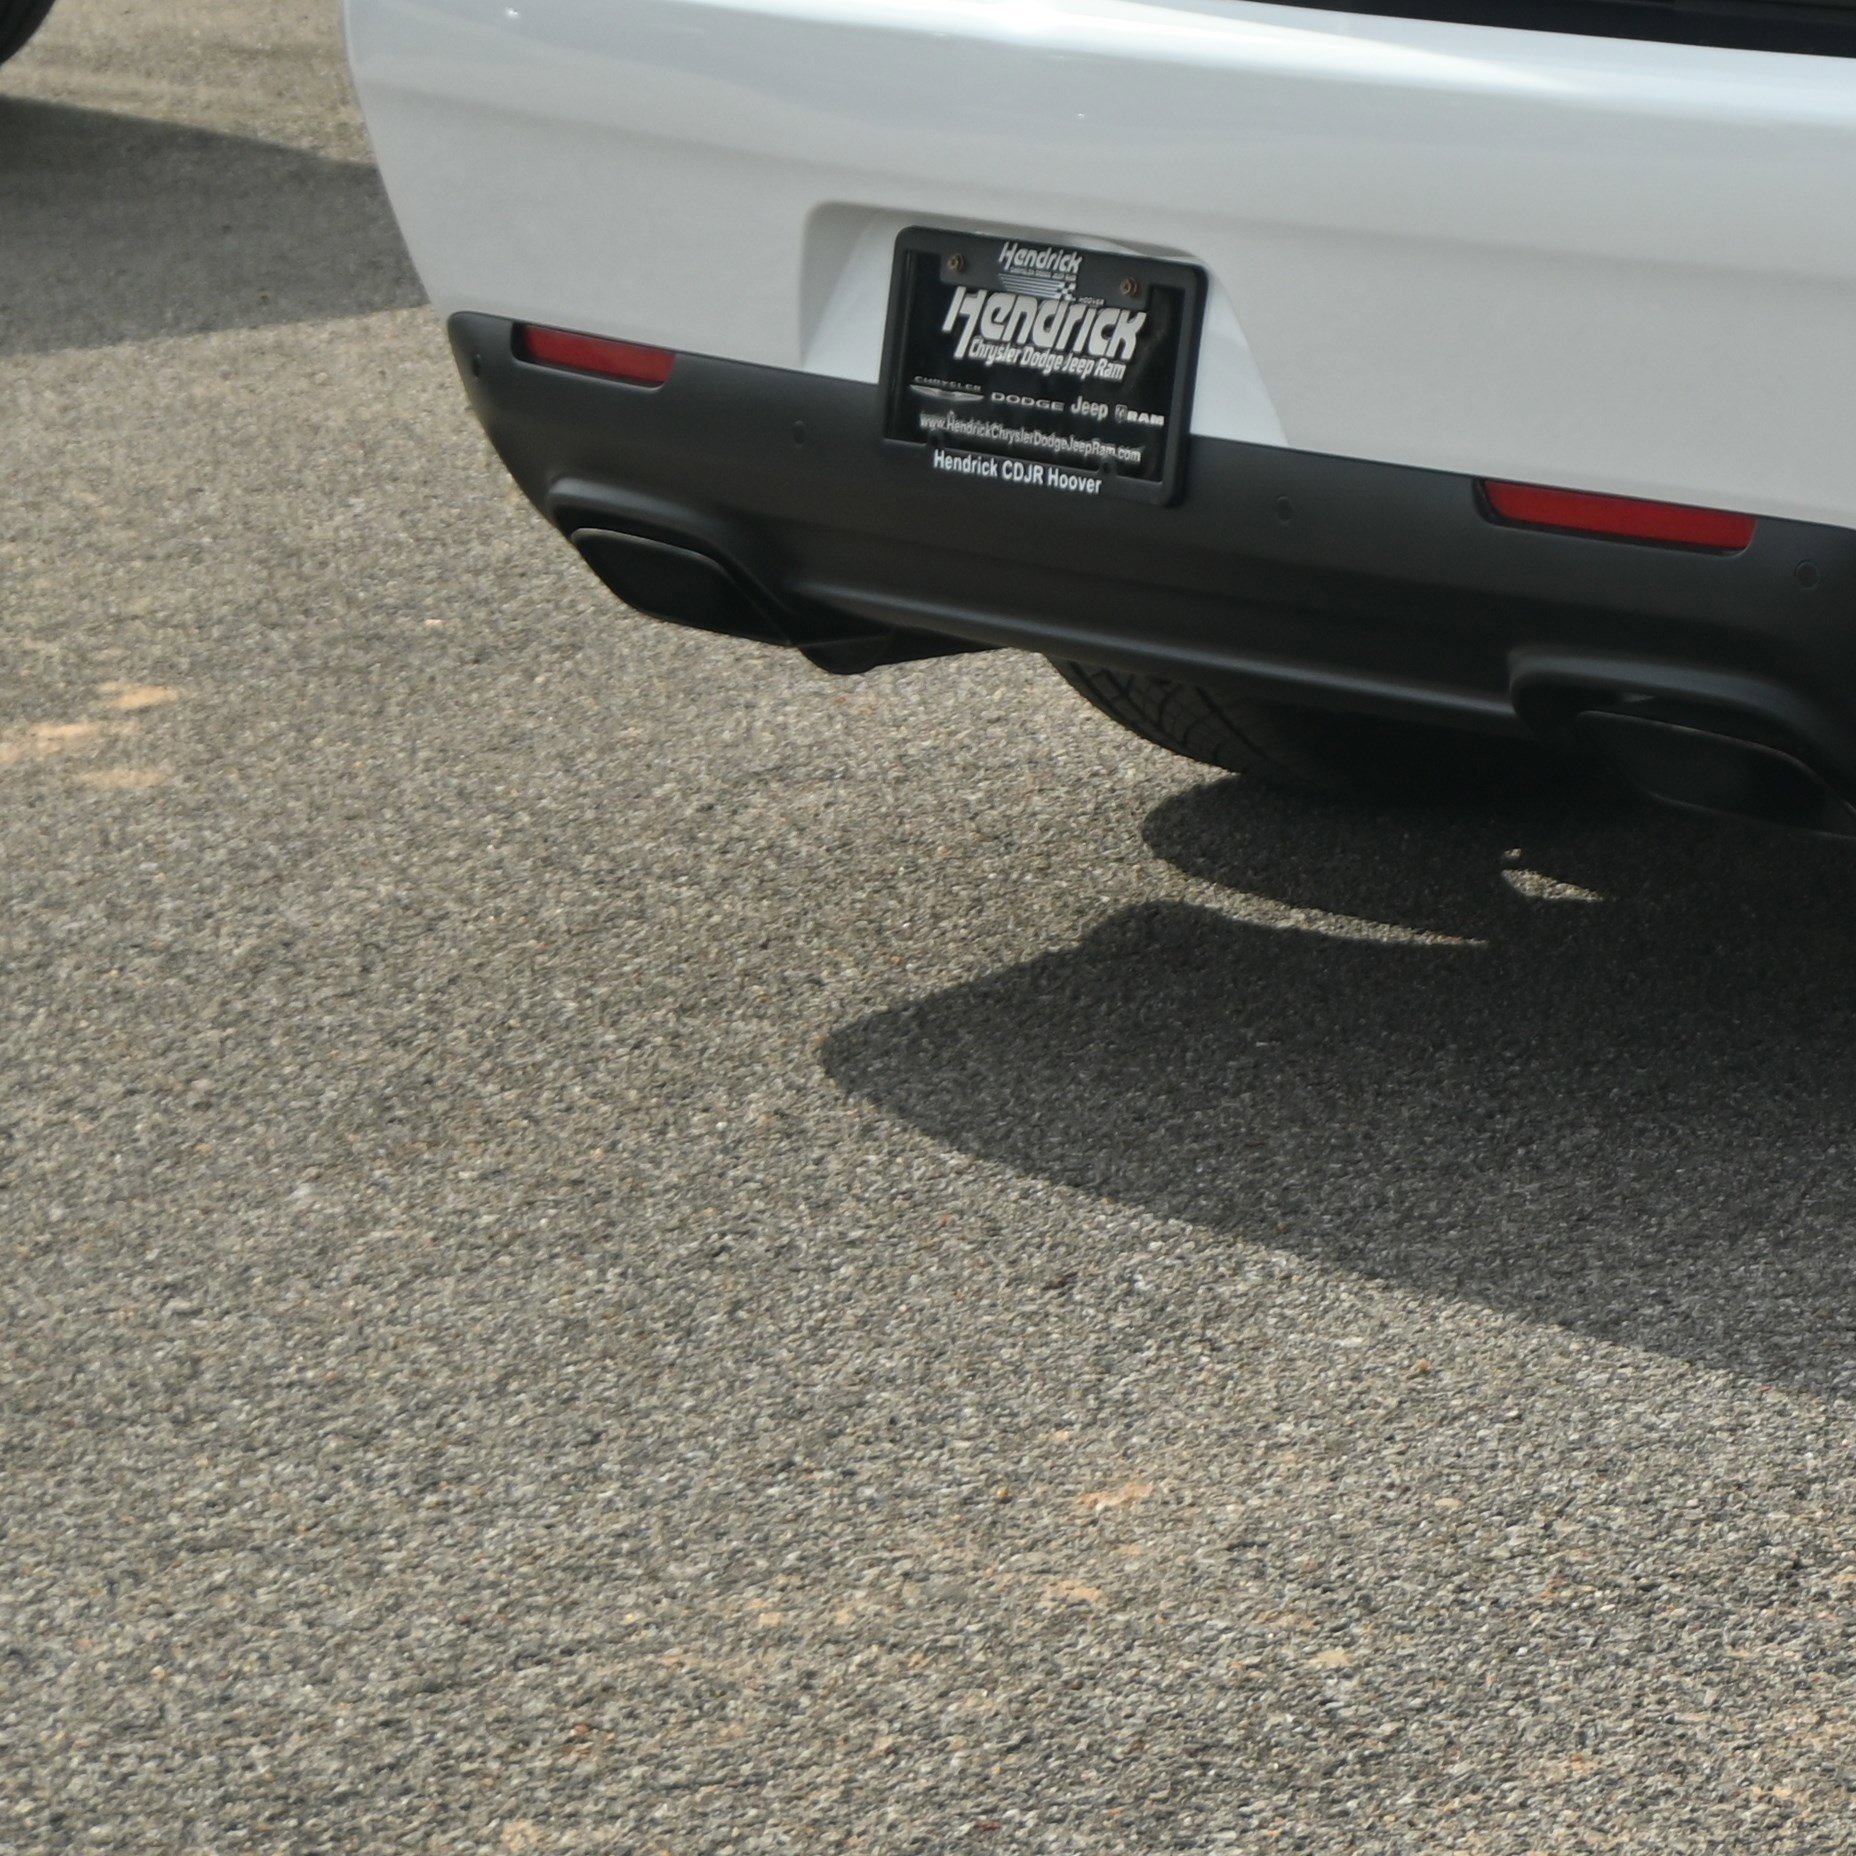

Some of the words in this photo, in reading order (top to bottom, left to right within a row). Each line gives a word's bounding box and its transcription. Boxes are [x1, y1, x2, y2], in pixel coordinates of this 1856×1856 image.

[998, 241, 1083, 274] Hendrick
[941, 286, 1147, 361] Hendrick
[967, 337, 1022, 367] Chrysler
[1020, 346, 1062, 376] Dodge
[1061, 352, 1095, 380] Jeep
[1093, 357, 1127, 382] Ram
[913, 375, 982, 392] CHRYSLER
[990, 392, 1065, 412] DODGE
[1070, 395, 1109, 421] Jeep
[1126, 410, 1166, 427] RAM
[919, 411, 1142, 463] www.HendrickChryslerDodgeJeepRam.com
[933, 449, 998, 478] Hendrick
[1001, 459, 1044, 485] CDJR
[1047, 467, 1102, 494] Hoover
